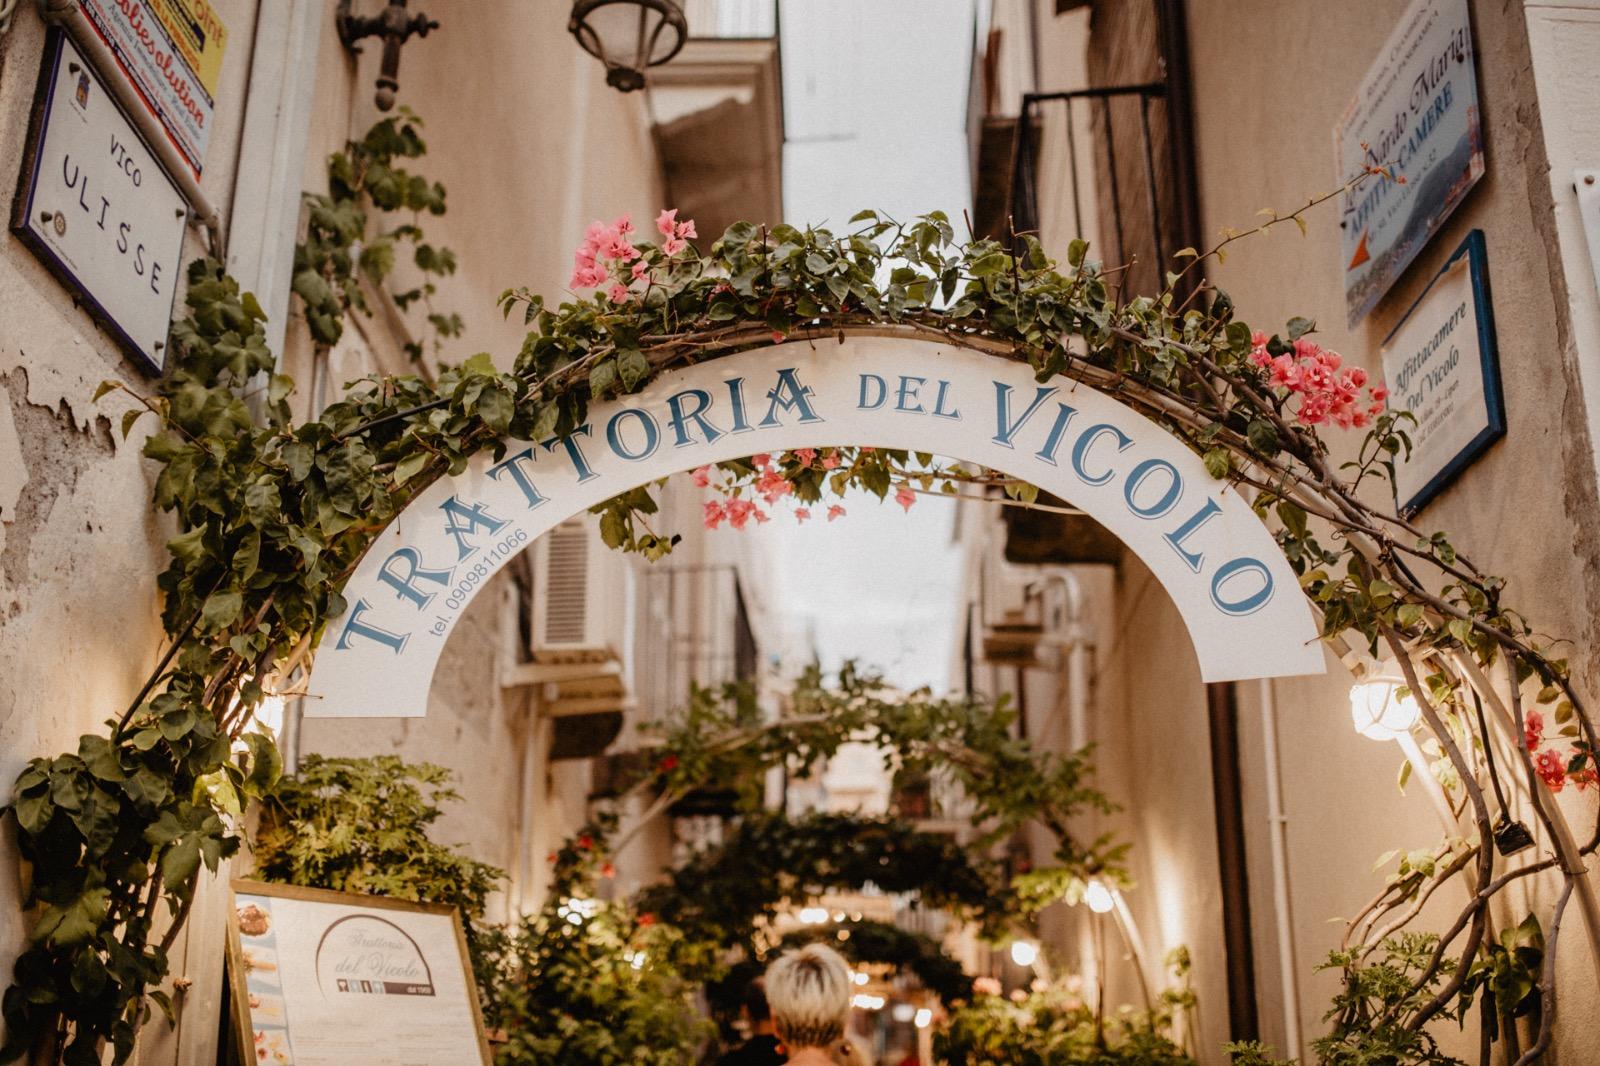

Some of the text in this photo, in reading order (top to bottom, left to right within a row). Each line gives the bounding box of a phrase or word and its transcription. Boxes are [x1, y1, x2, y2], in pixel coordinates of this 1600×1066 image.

[1410, 28, 1463, 114] Maria
[111, 134, 142, 187] VICO
[1398, 81, 1453, 169] CAMERE
[63, 154, 162, 295] ULISSE
[1394, 301, 1467, 396] Affittacamere
[1406, 377, 1425, 412] Del
[1425, 344, 1460, 392] Vicolo
[335, 367, 1275, 655] TRATTORIA DEL VICOLO
[429, 528, 528, 637] tel. 0909811066
